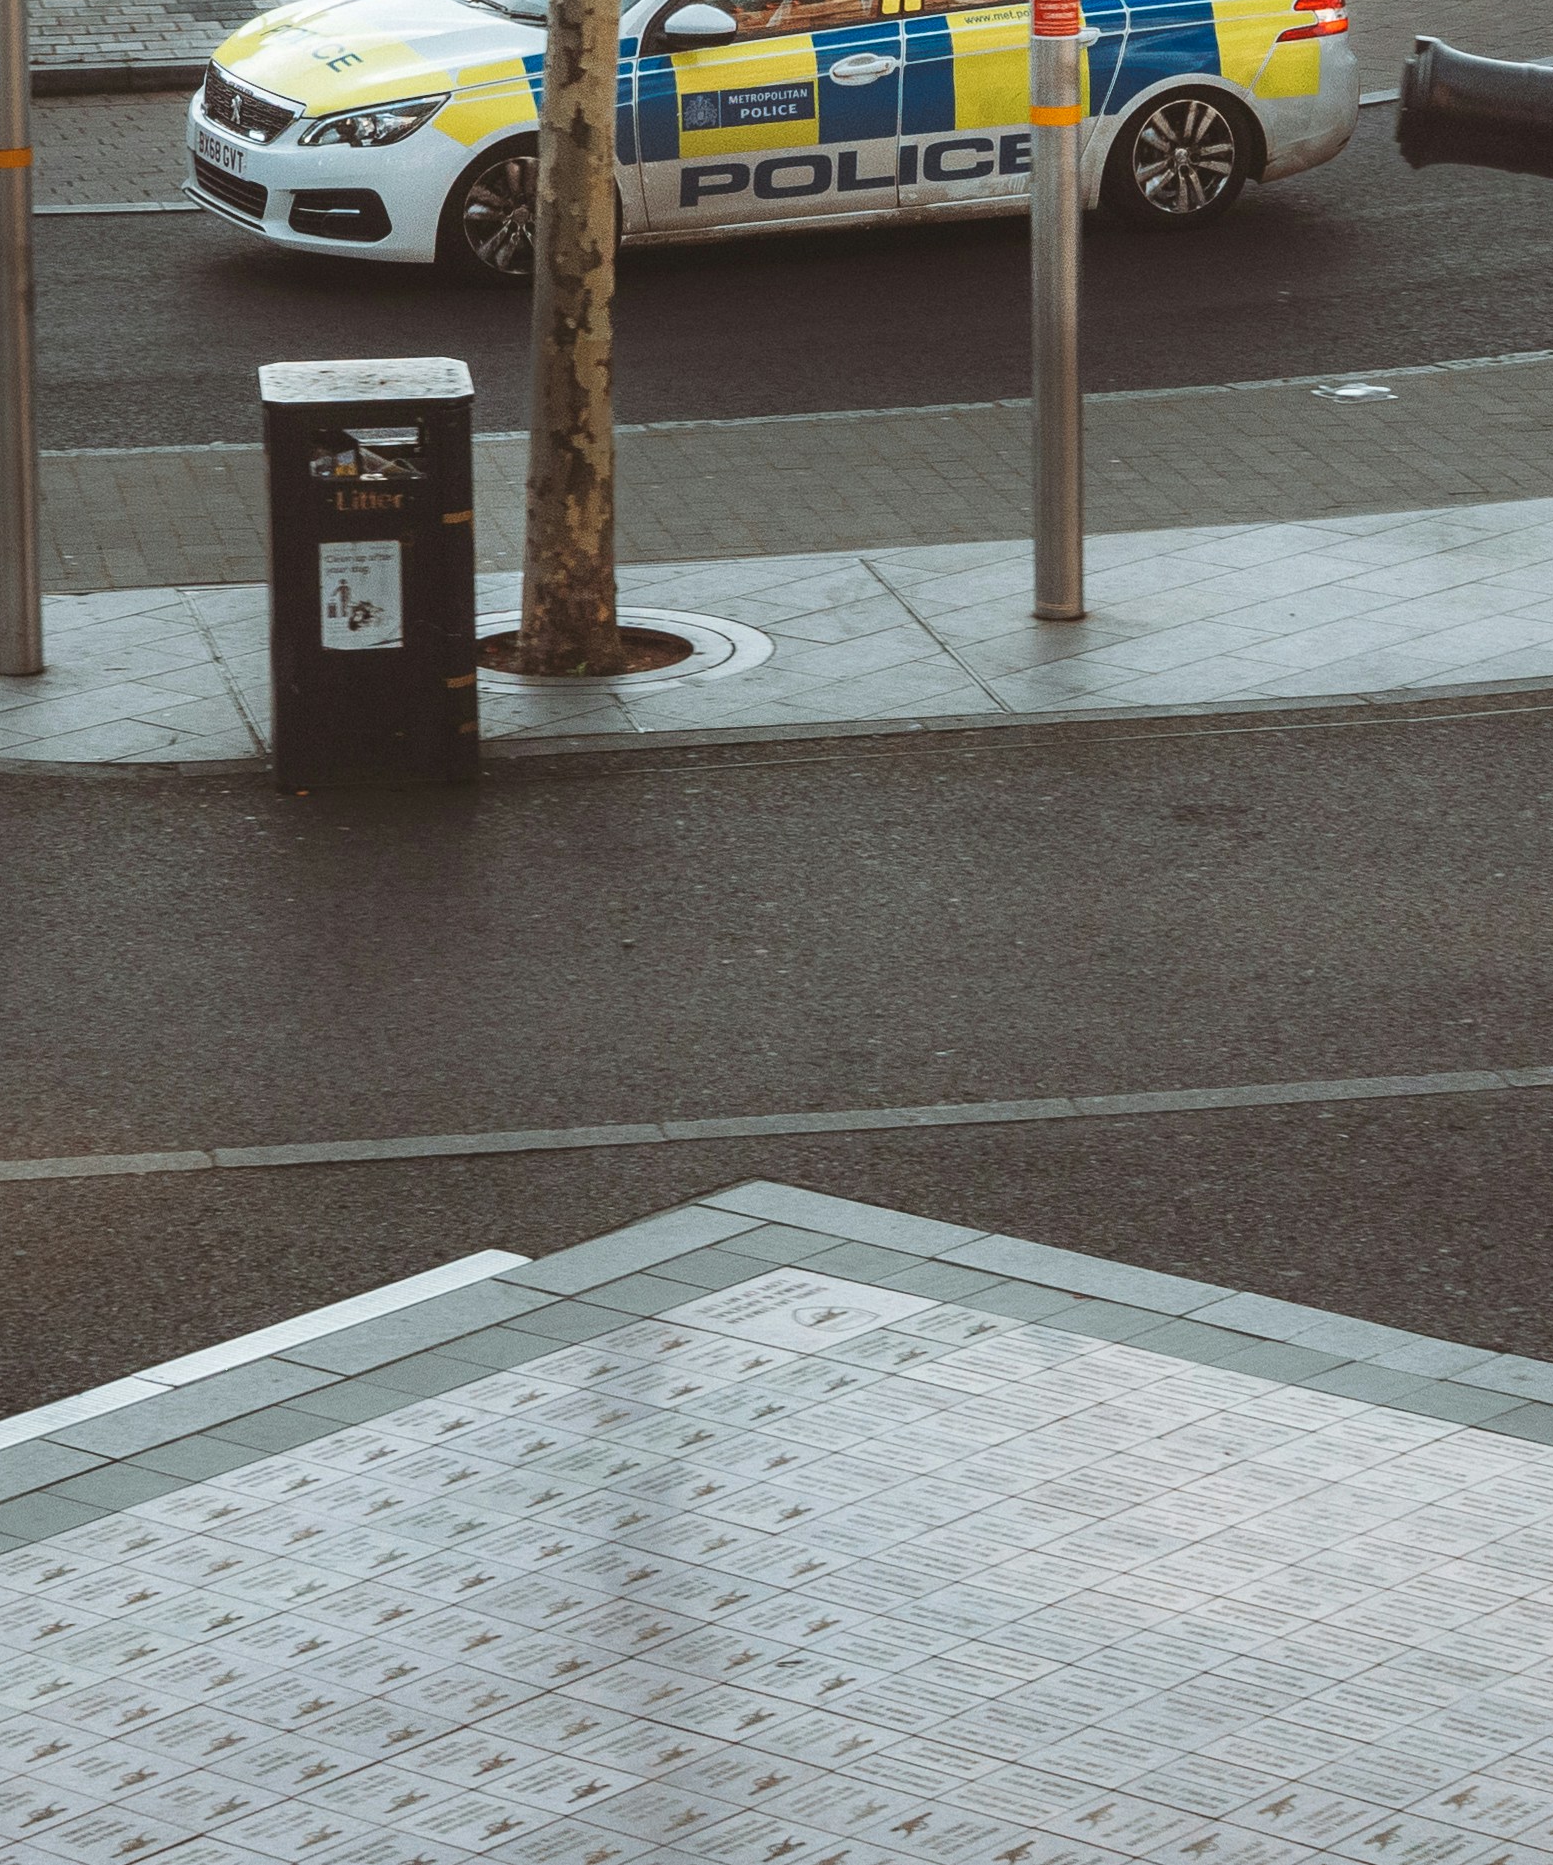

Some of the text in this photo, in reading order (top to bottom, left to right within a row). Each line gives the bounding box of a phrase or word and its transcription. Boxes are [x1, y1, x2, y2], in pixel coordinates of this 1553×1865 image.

[964, 9, 1031, 25] www.met.po
[728, 87, 809, 106] METROPOLITAN
[740, 103, 798, 119] POLICE
[223, 144, 245, 174] GVT
[679, 133, 1031, 208] POLICE
[336, 489, 403, 511] Litter
